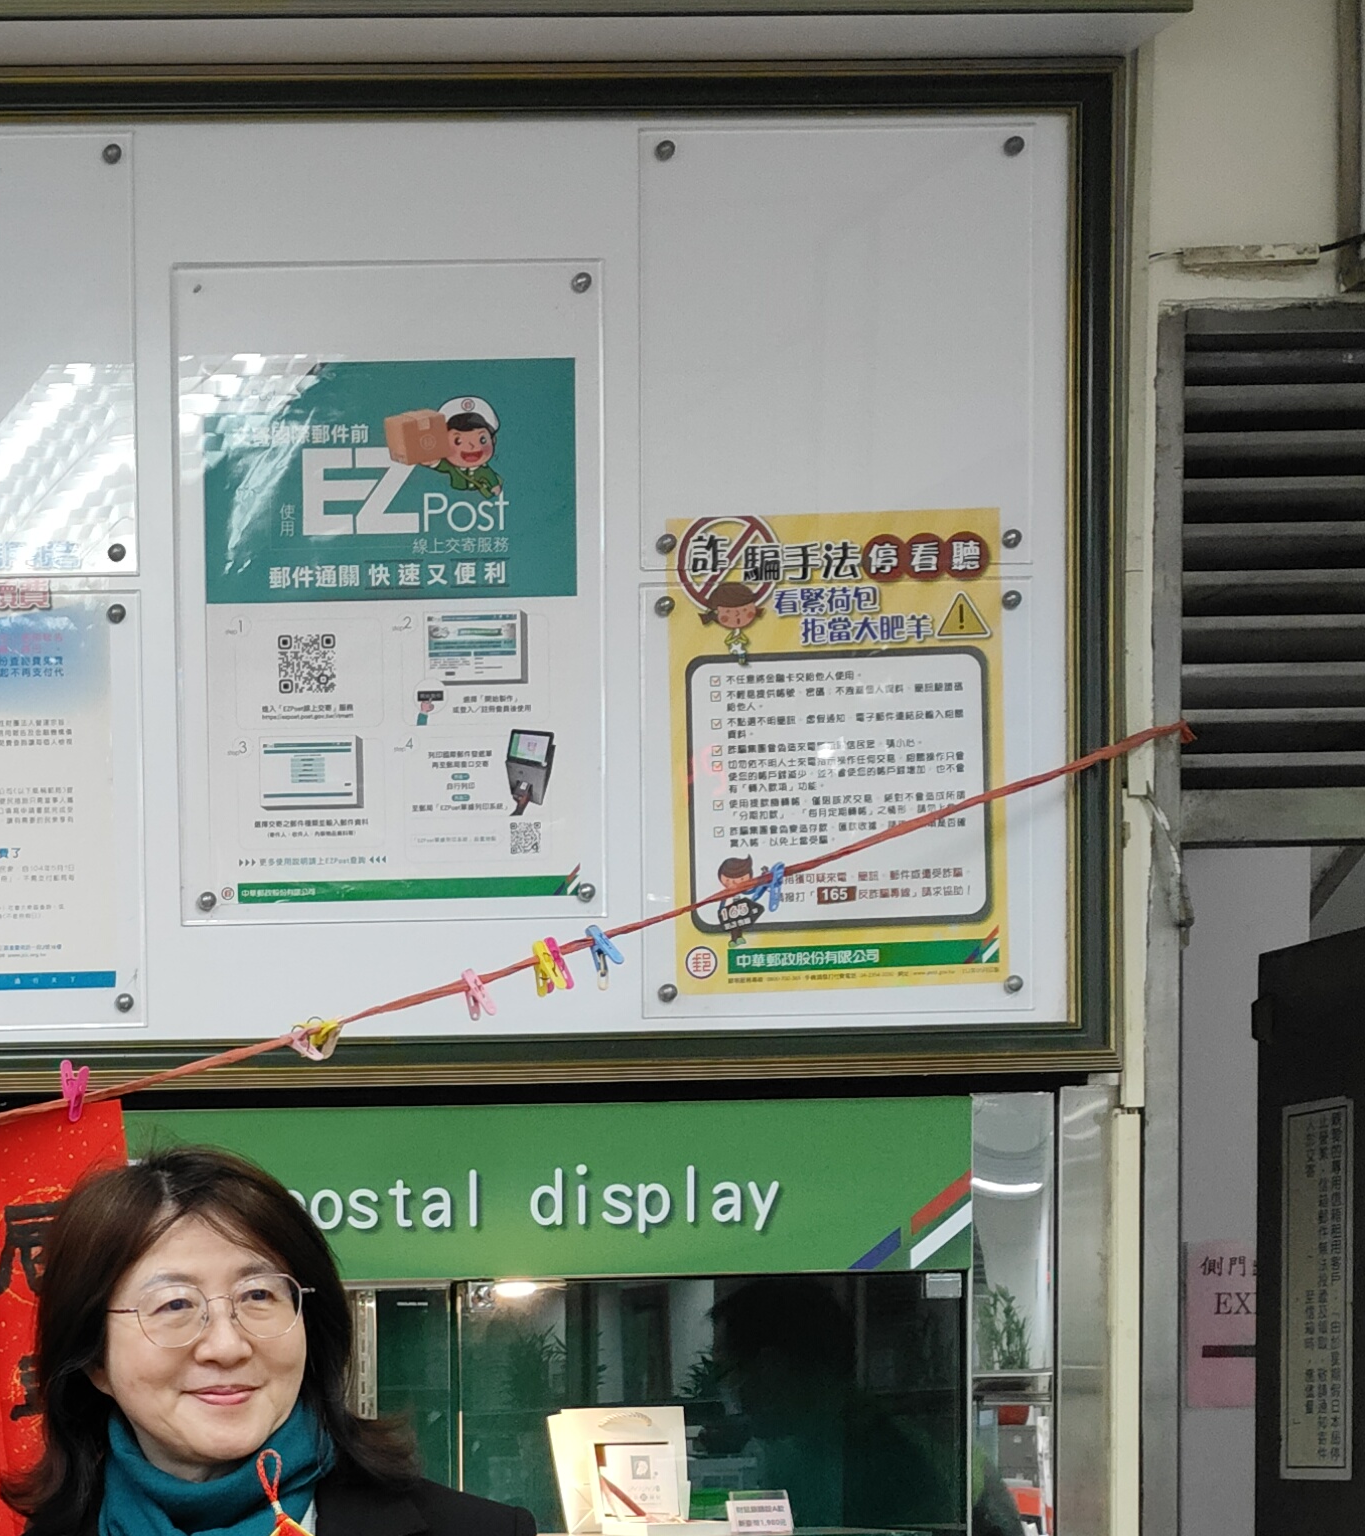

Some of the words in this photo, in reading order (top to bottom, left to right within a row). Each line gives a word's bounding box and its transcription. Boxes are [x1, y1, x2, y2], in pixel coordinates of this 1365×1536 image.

[302, 447, 420, 536] EZ
[279, 503, 296, 538] 使用
[422, 495, 510, 533] Post
[412, 537, 510, 555] 線上交寄服務
[269, 564, 361, 589] 郵件通關
[368, 560, 508, 588] 快速又便利
[773, 585, 880, 617] 看緊荷包
[801, 613, 933, 645] 拒當大肥羊
[736, 949, 880, 968] 中華郵政股份有限公司
[528, 1163, 781, 1235] display
